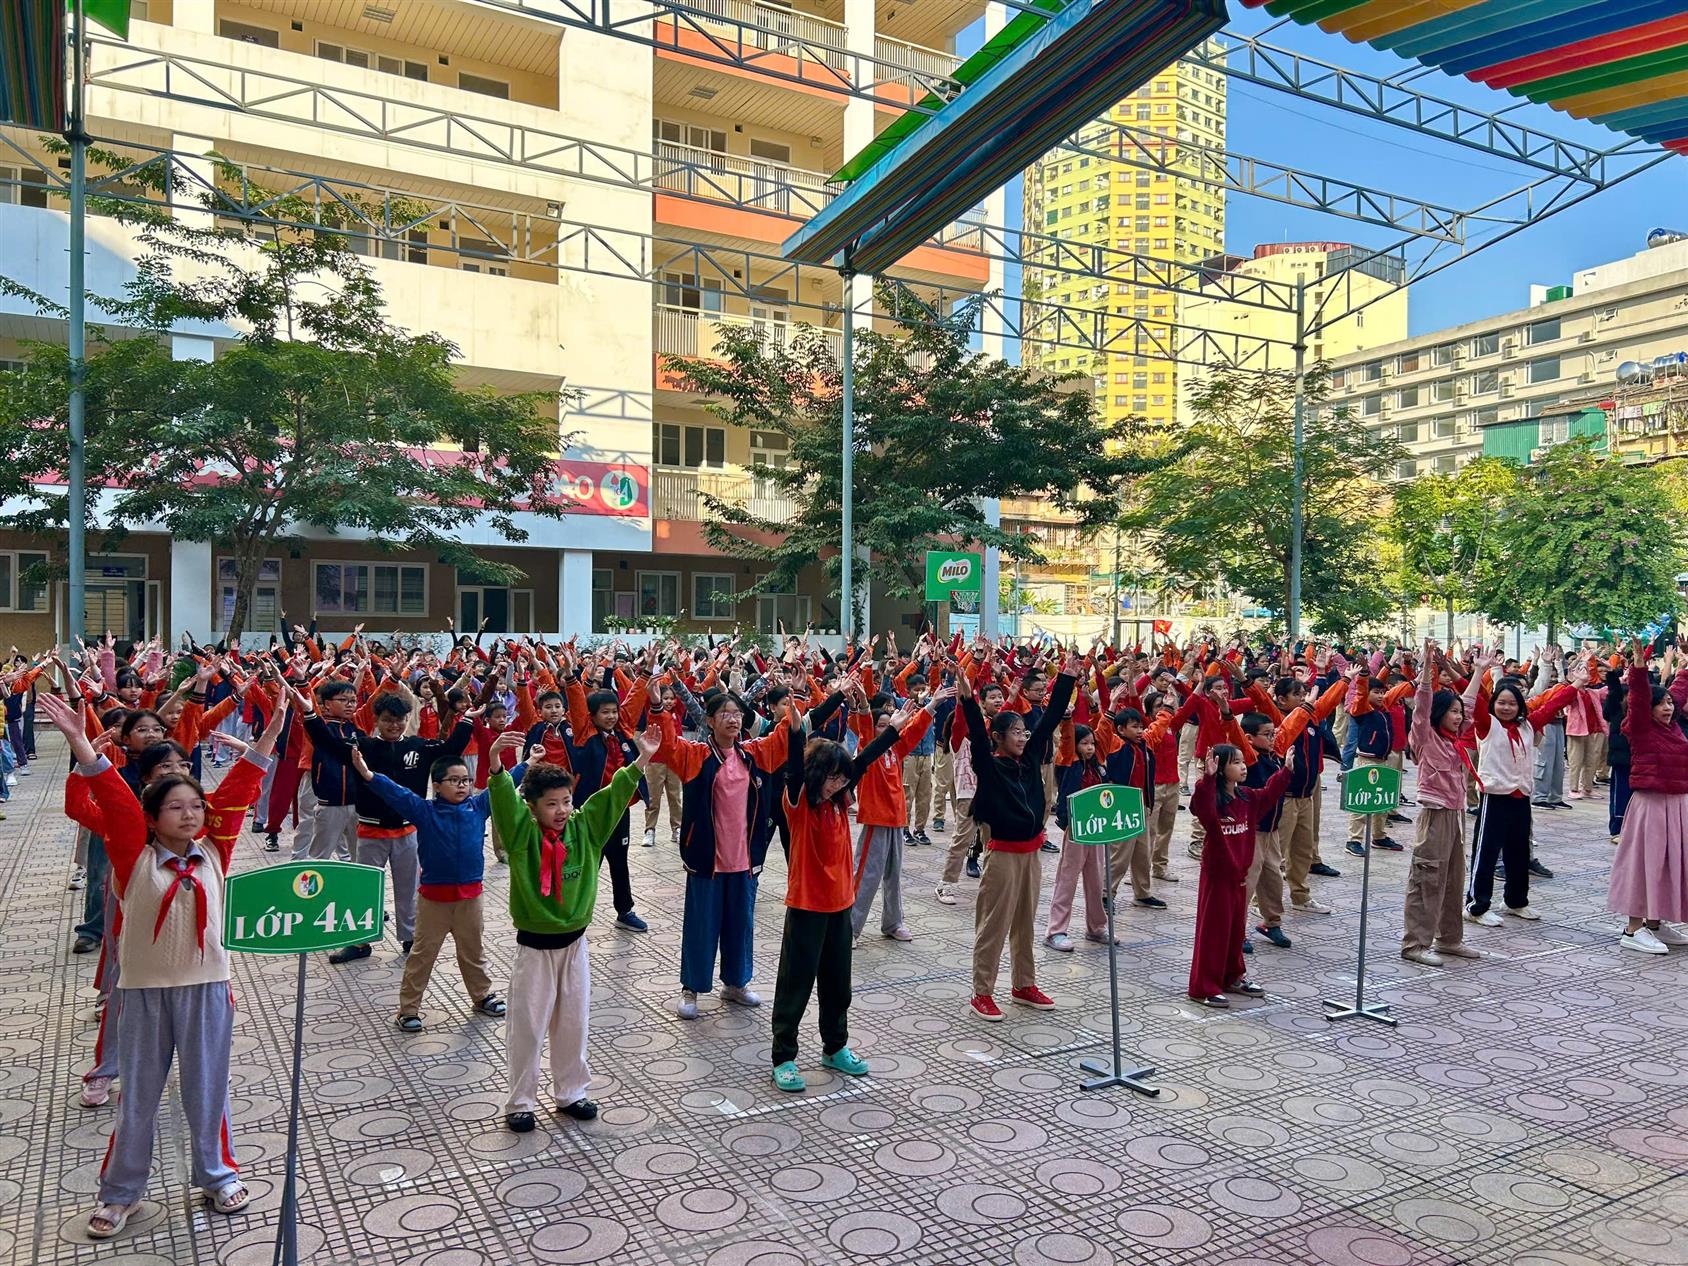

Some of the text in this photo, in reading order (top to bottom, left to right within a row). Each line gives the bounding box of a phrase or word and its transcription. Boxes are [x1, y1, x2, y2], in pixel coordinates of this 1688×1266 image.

[942, 565, 968, 577] MILO
[1347, 786, 1395, 806] LỚP 5A1
[1077, 809, 1140, 837] LỚP 4A5
[234, 901, 374, 940] LỚP 4A4
